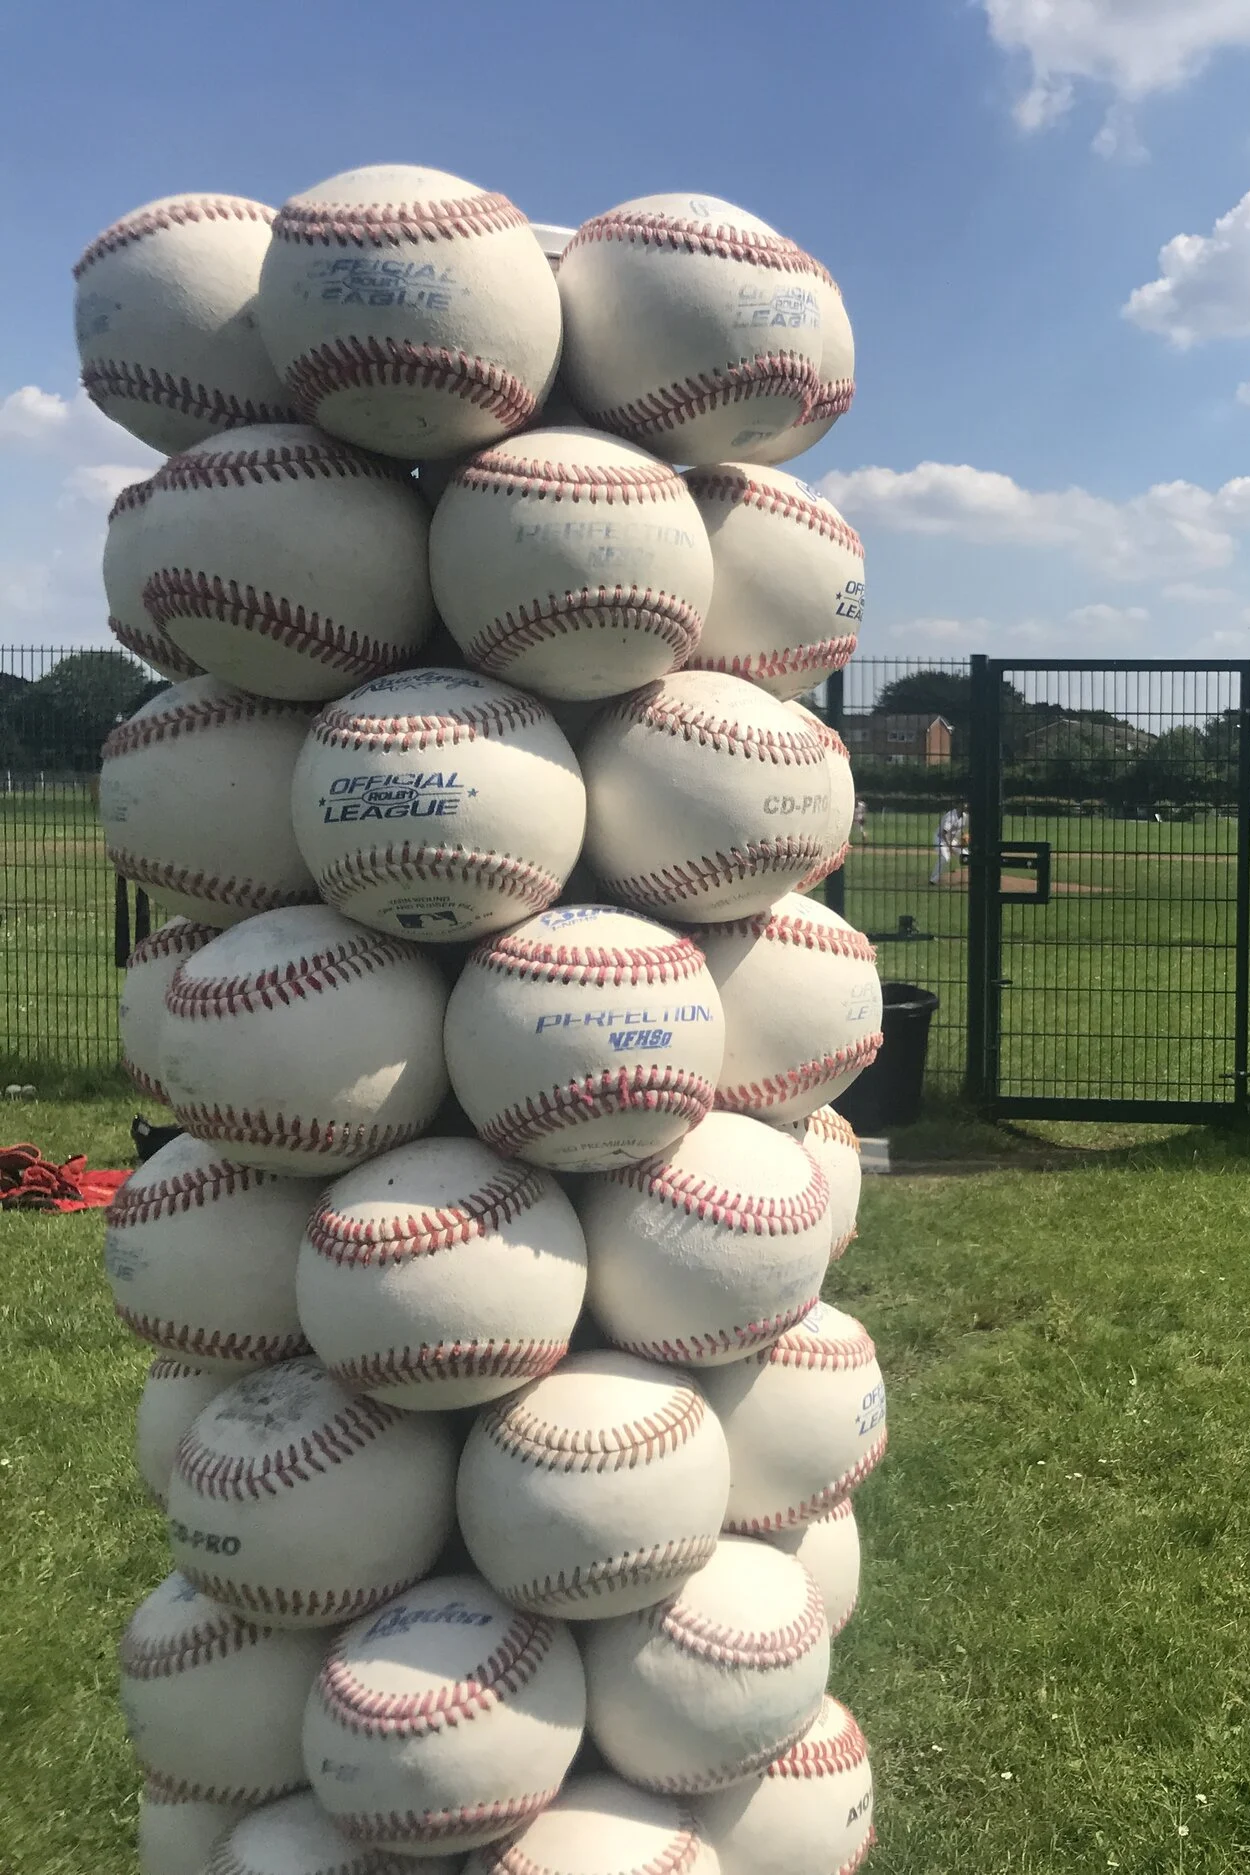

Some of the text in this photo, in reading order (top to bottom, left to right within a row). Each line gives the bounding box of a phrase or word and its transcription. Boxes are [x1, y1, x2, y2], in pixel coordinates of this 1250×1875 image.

[329, 772, 464, 795] OFFICIAL
[323, 799, 461, 824] LEAGUE
[535, 1004, 711, 1034] PERFECTION
